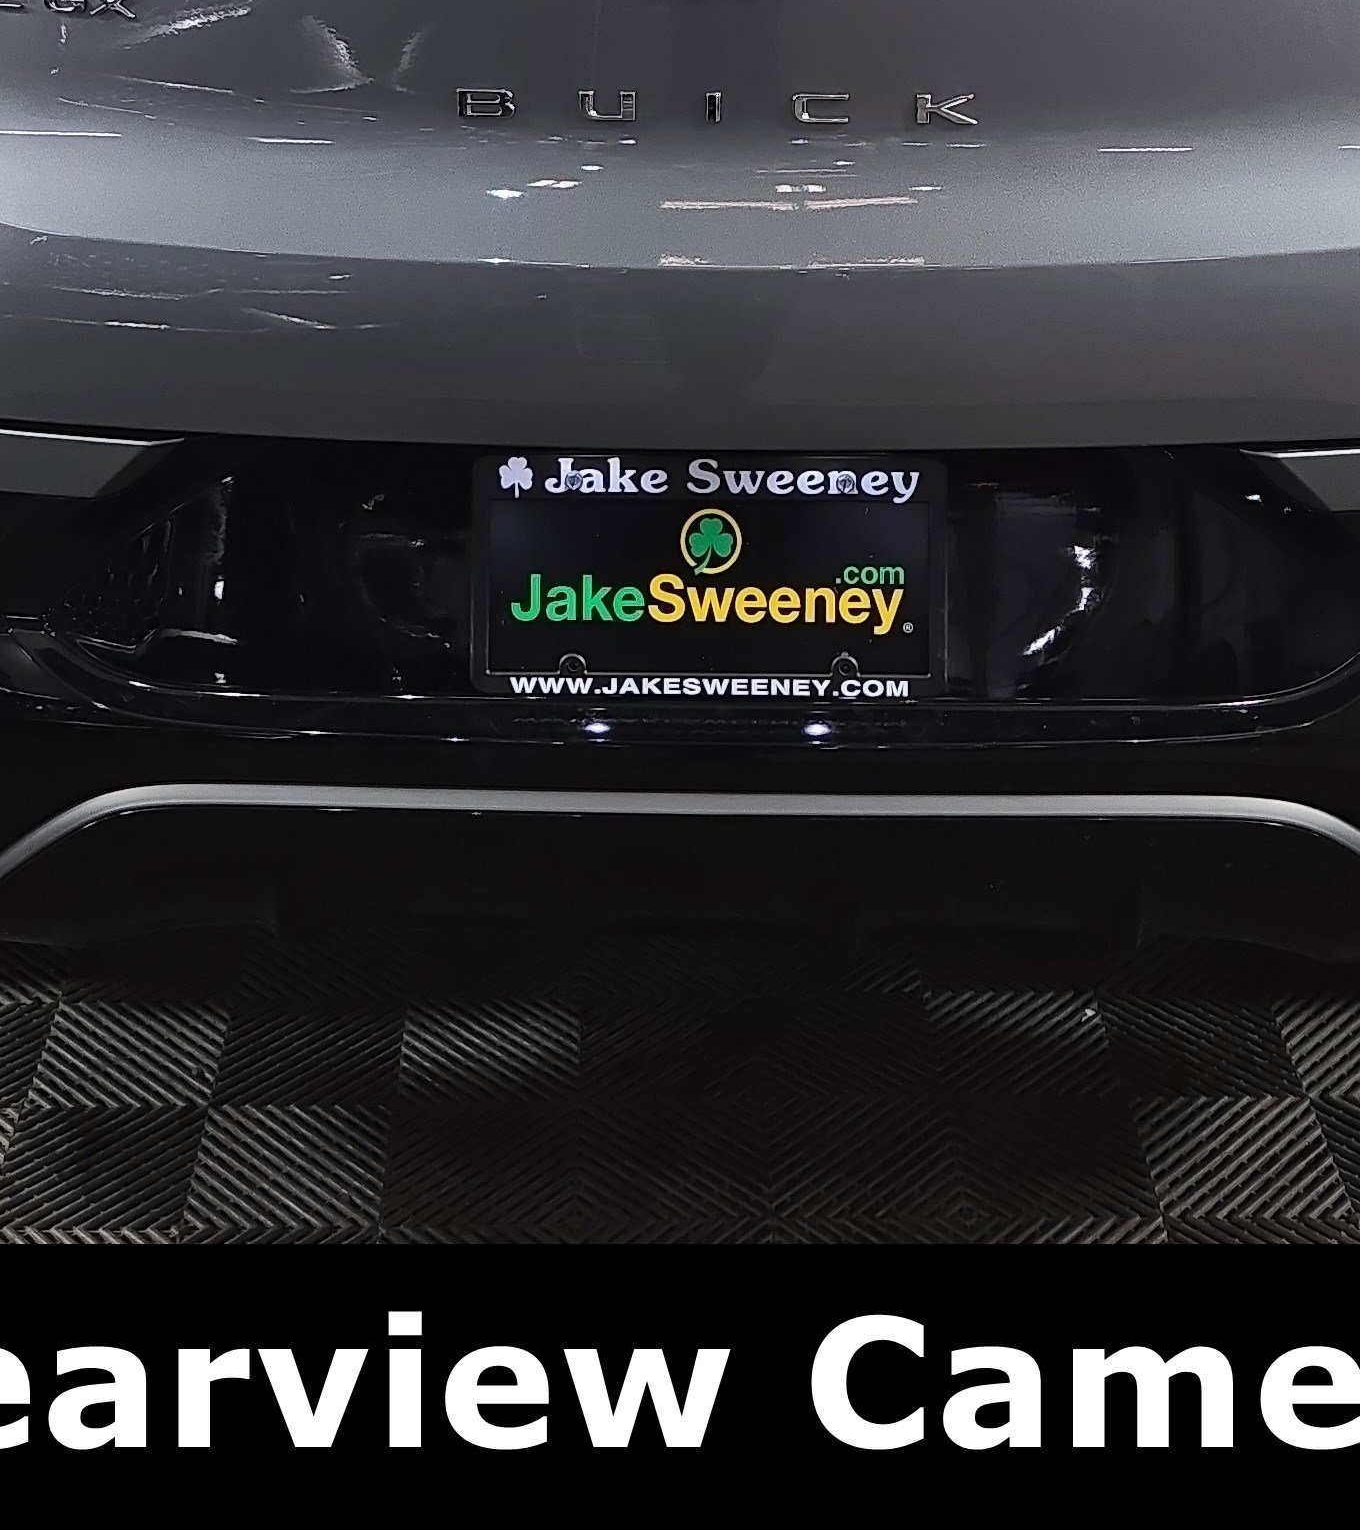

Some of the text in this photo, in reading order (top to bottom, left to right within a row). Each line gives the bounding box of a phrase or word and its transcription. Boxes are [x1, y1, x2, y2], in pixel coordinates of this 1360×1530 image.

[456, 88, 979, 125] BUICK
[545, 457, 920, 503] Jake Sweeney
[834, 565, 905, 586] .com
[510, 676, 910, 698] WWW.JAKESWEENEY.COM
